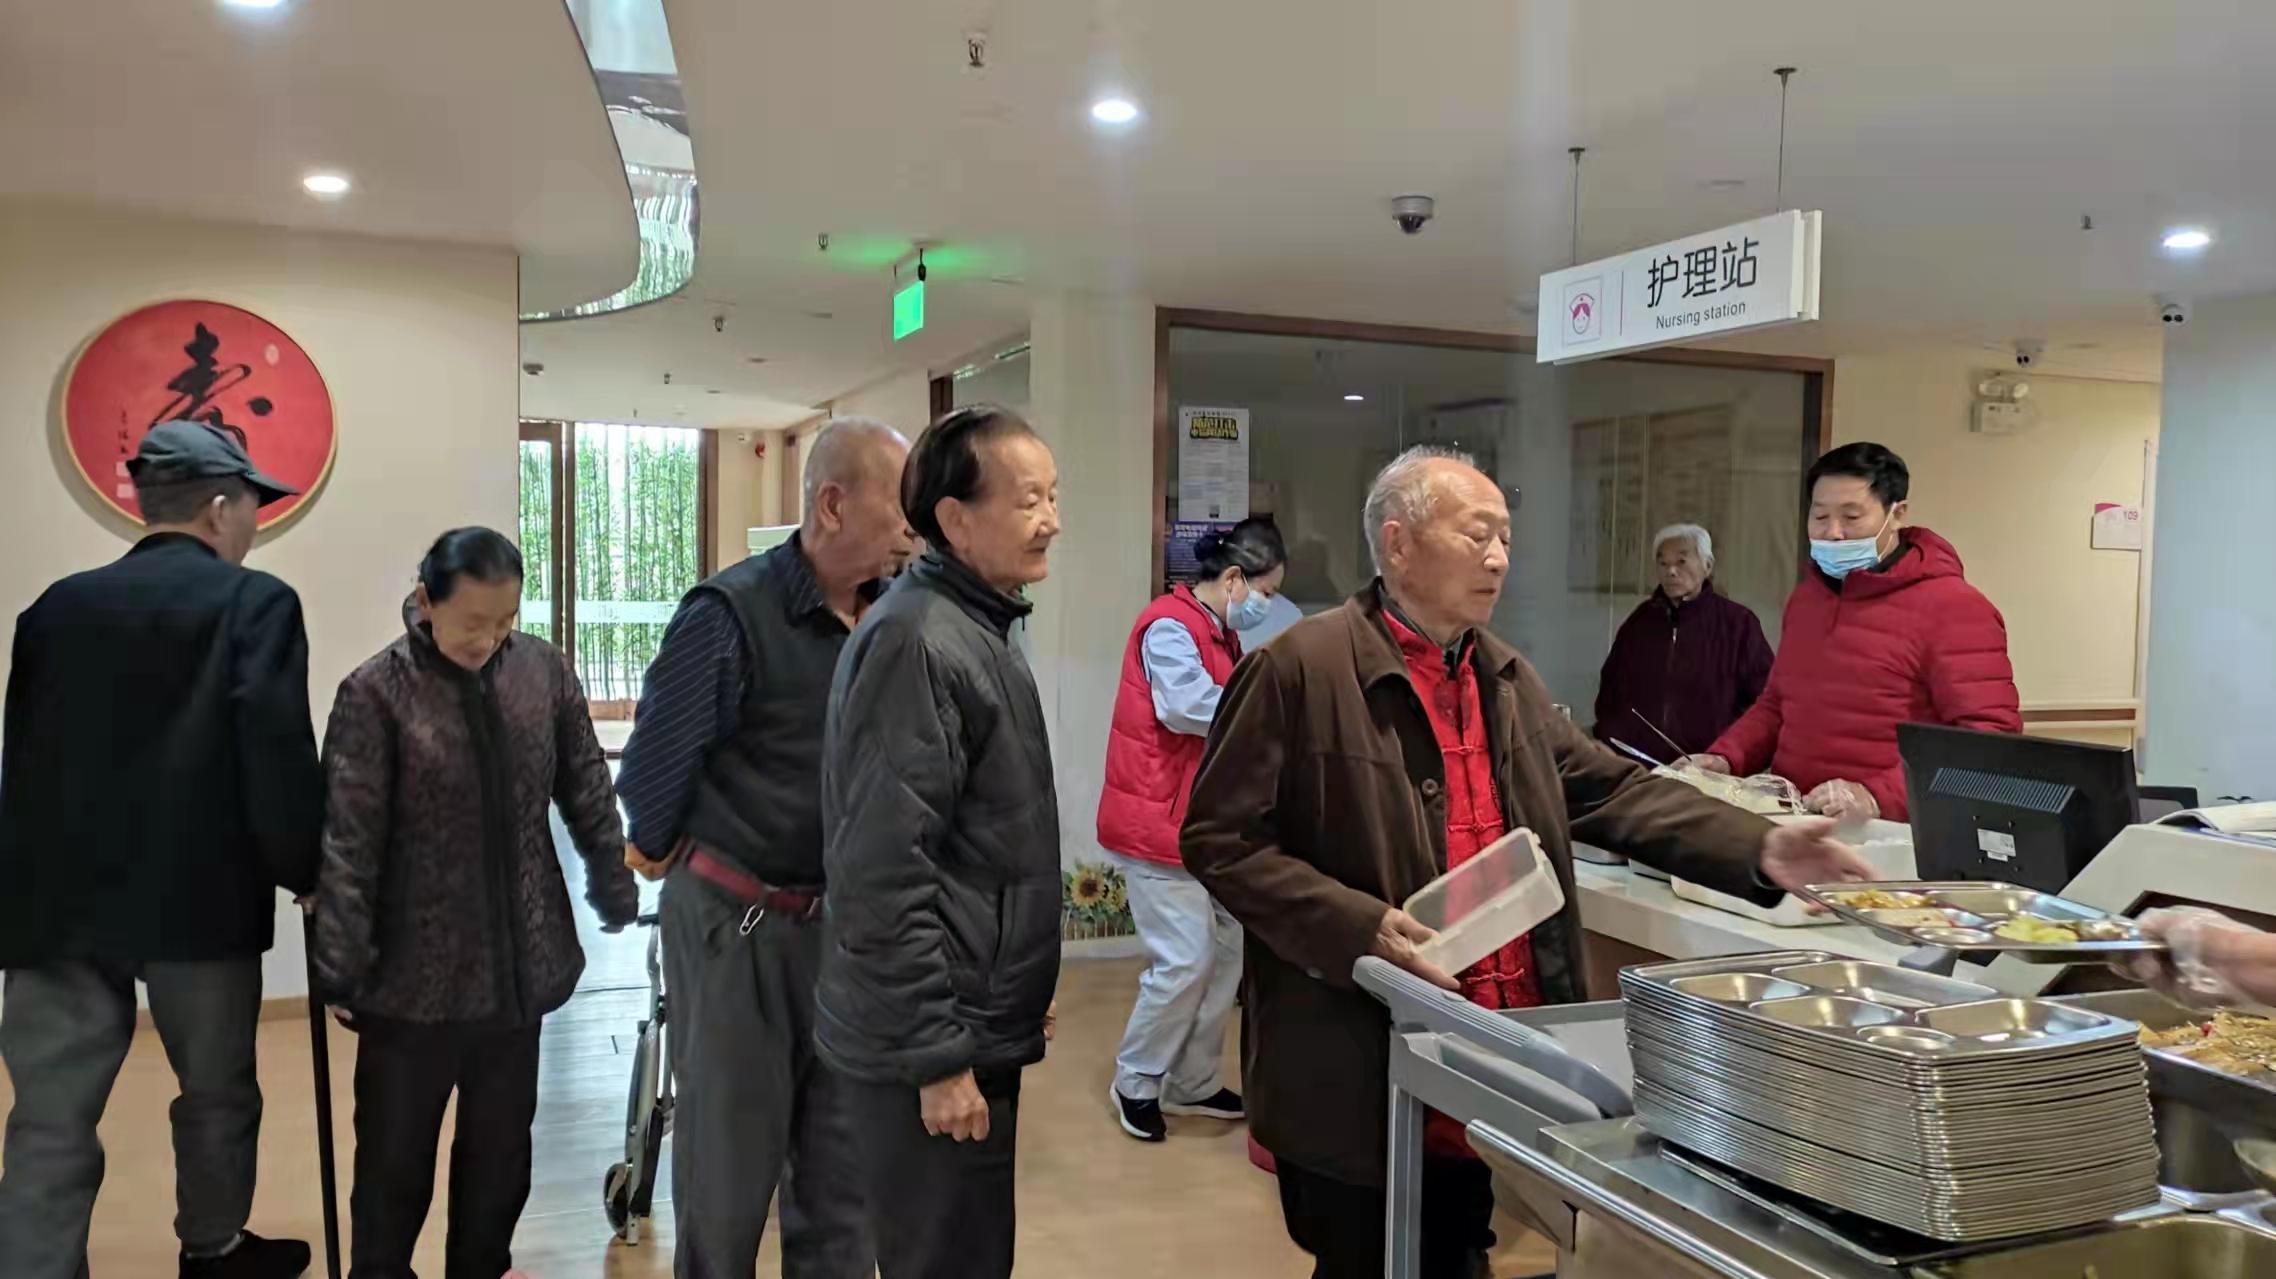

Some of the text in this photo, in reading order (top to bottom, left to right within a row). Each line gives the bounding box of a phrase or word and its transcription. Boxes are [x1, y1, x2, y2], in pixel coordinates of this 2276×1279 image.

[1647, 236, 1760, 308] 护理站
[1656, 301, 1746, 329] Nursing station
